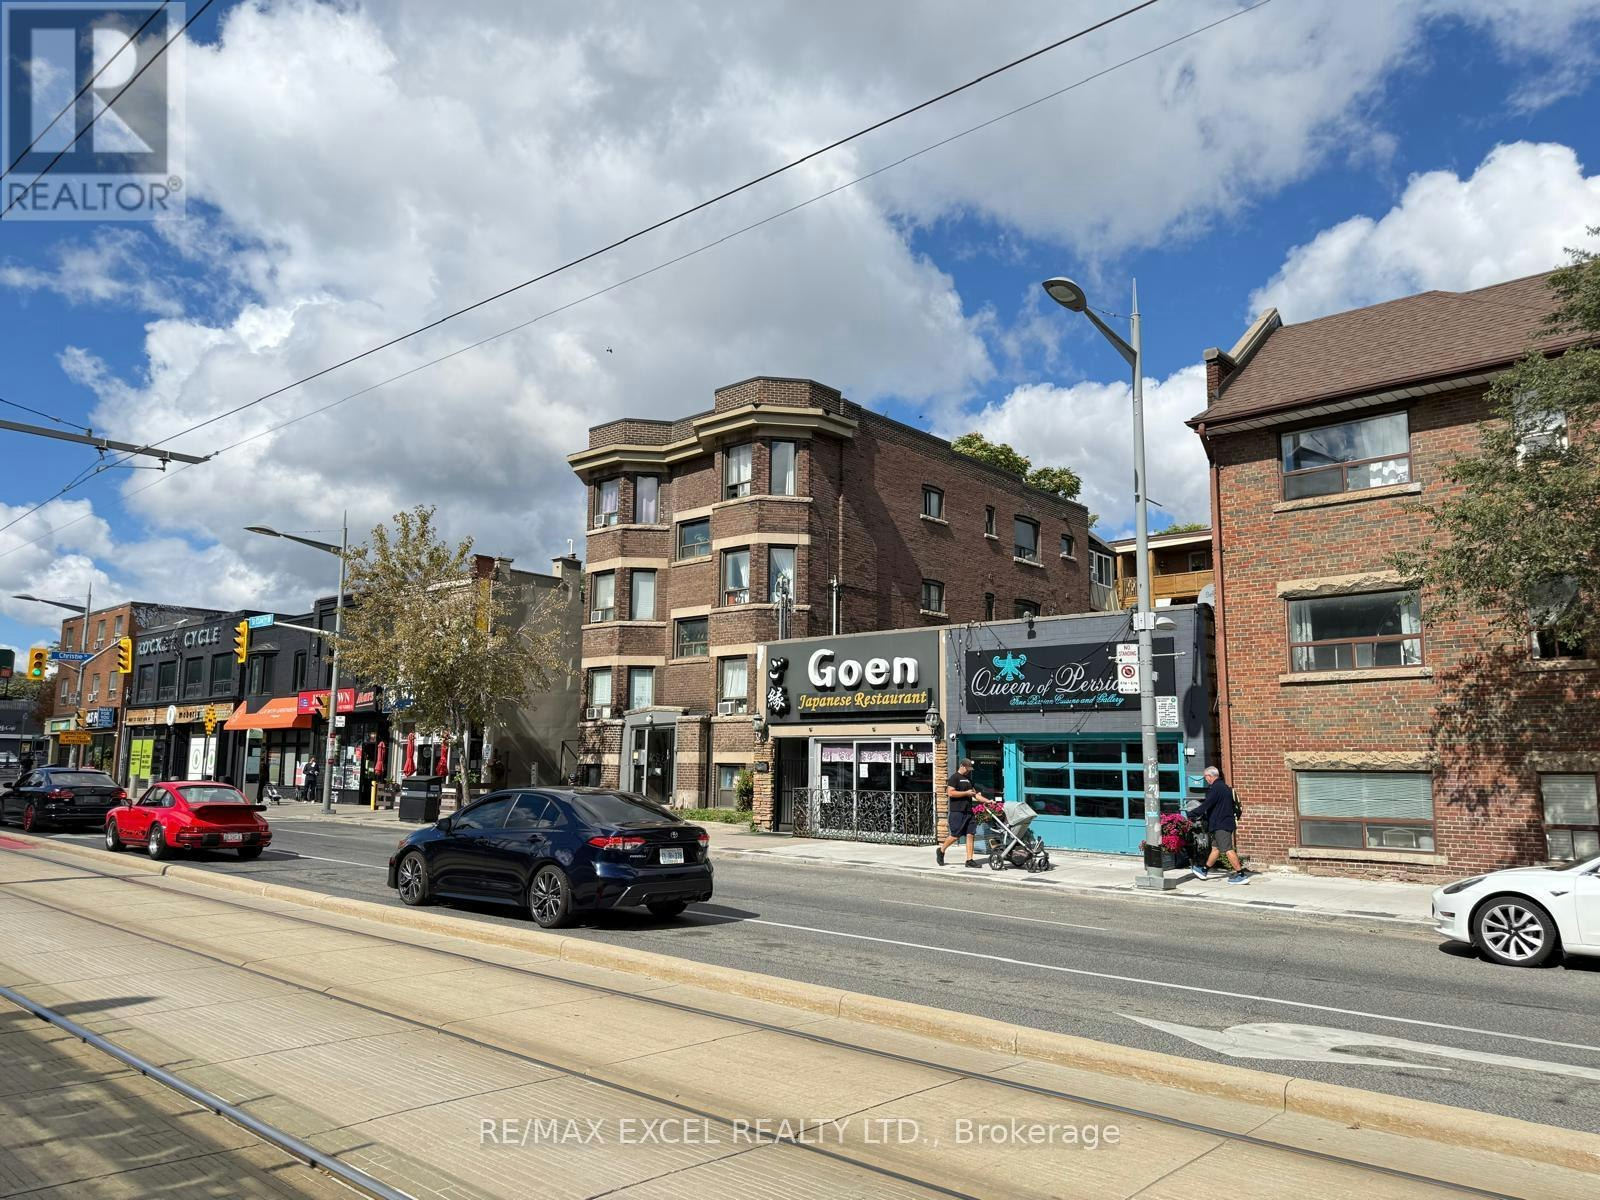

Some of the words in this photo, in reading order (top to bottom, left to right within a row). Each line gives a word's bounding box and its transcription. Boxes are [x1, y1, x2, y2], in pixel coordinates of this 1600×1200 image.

[184, 626, 220, 648] CYCLE
[808, 648, 919, 688] Goen
[971, 666, 1035, 697] Queen
[1037, 679, 1053, 696] of
[798, 694, 852, 711] Japanese
[854, 691, 927, 708] Restaurant
